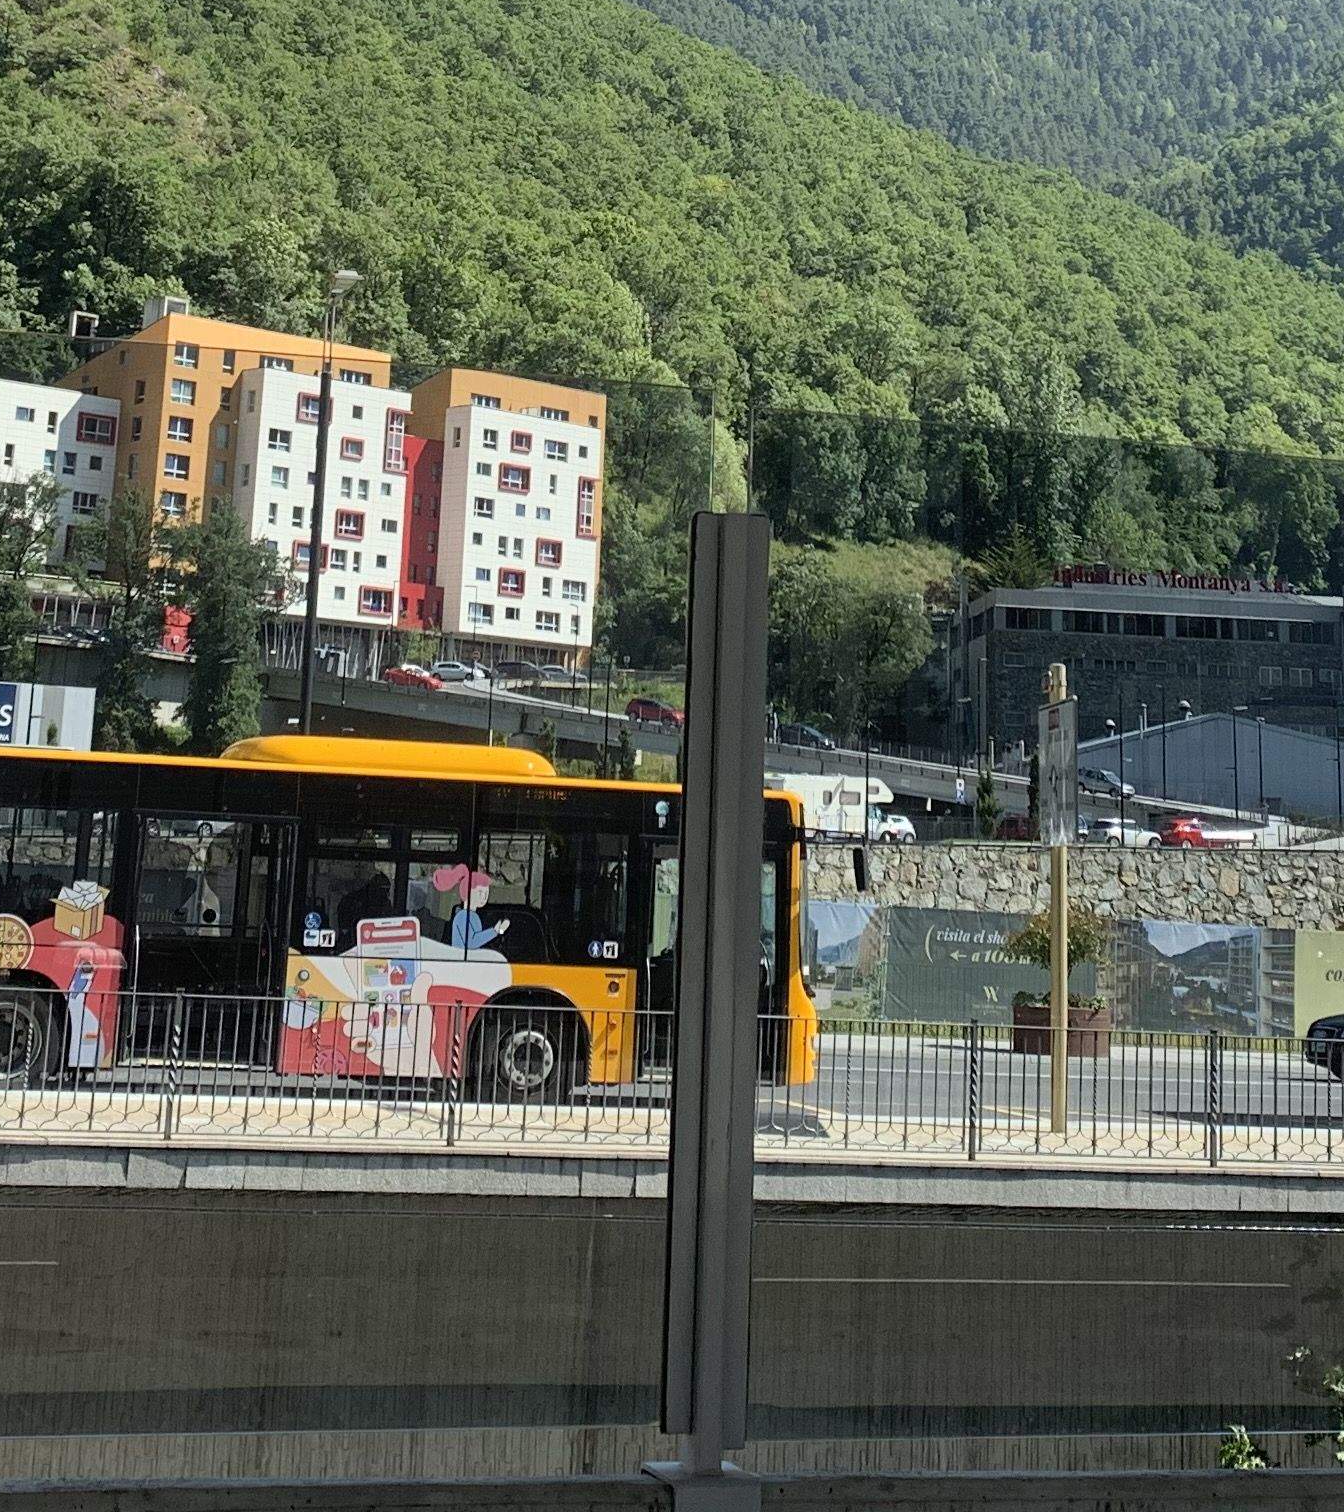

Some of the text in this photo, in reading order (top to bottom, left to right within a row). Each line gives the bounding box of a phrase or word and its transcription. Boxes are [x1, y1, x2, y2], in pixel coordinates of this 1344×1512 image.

[936, 926, 972, 944] visita
[973, 928, 985, 945] el
[971, 950, 981, 964] a
